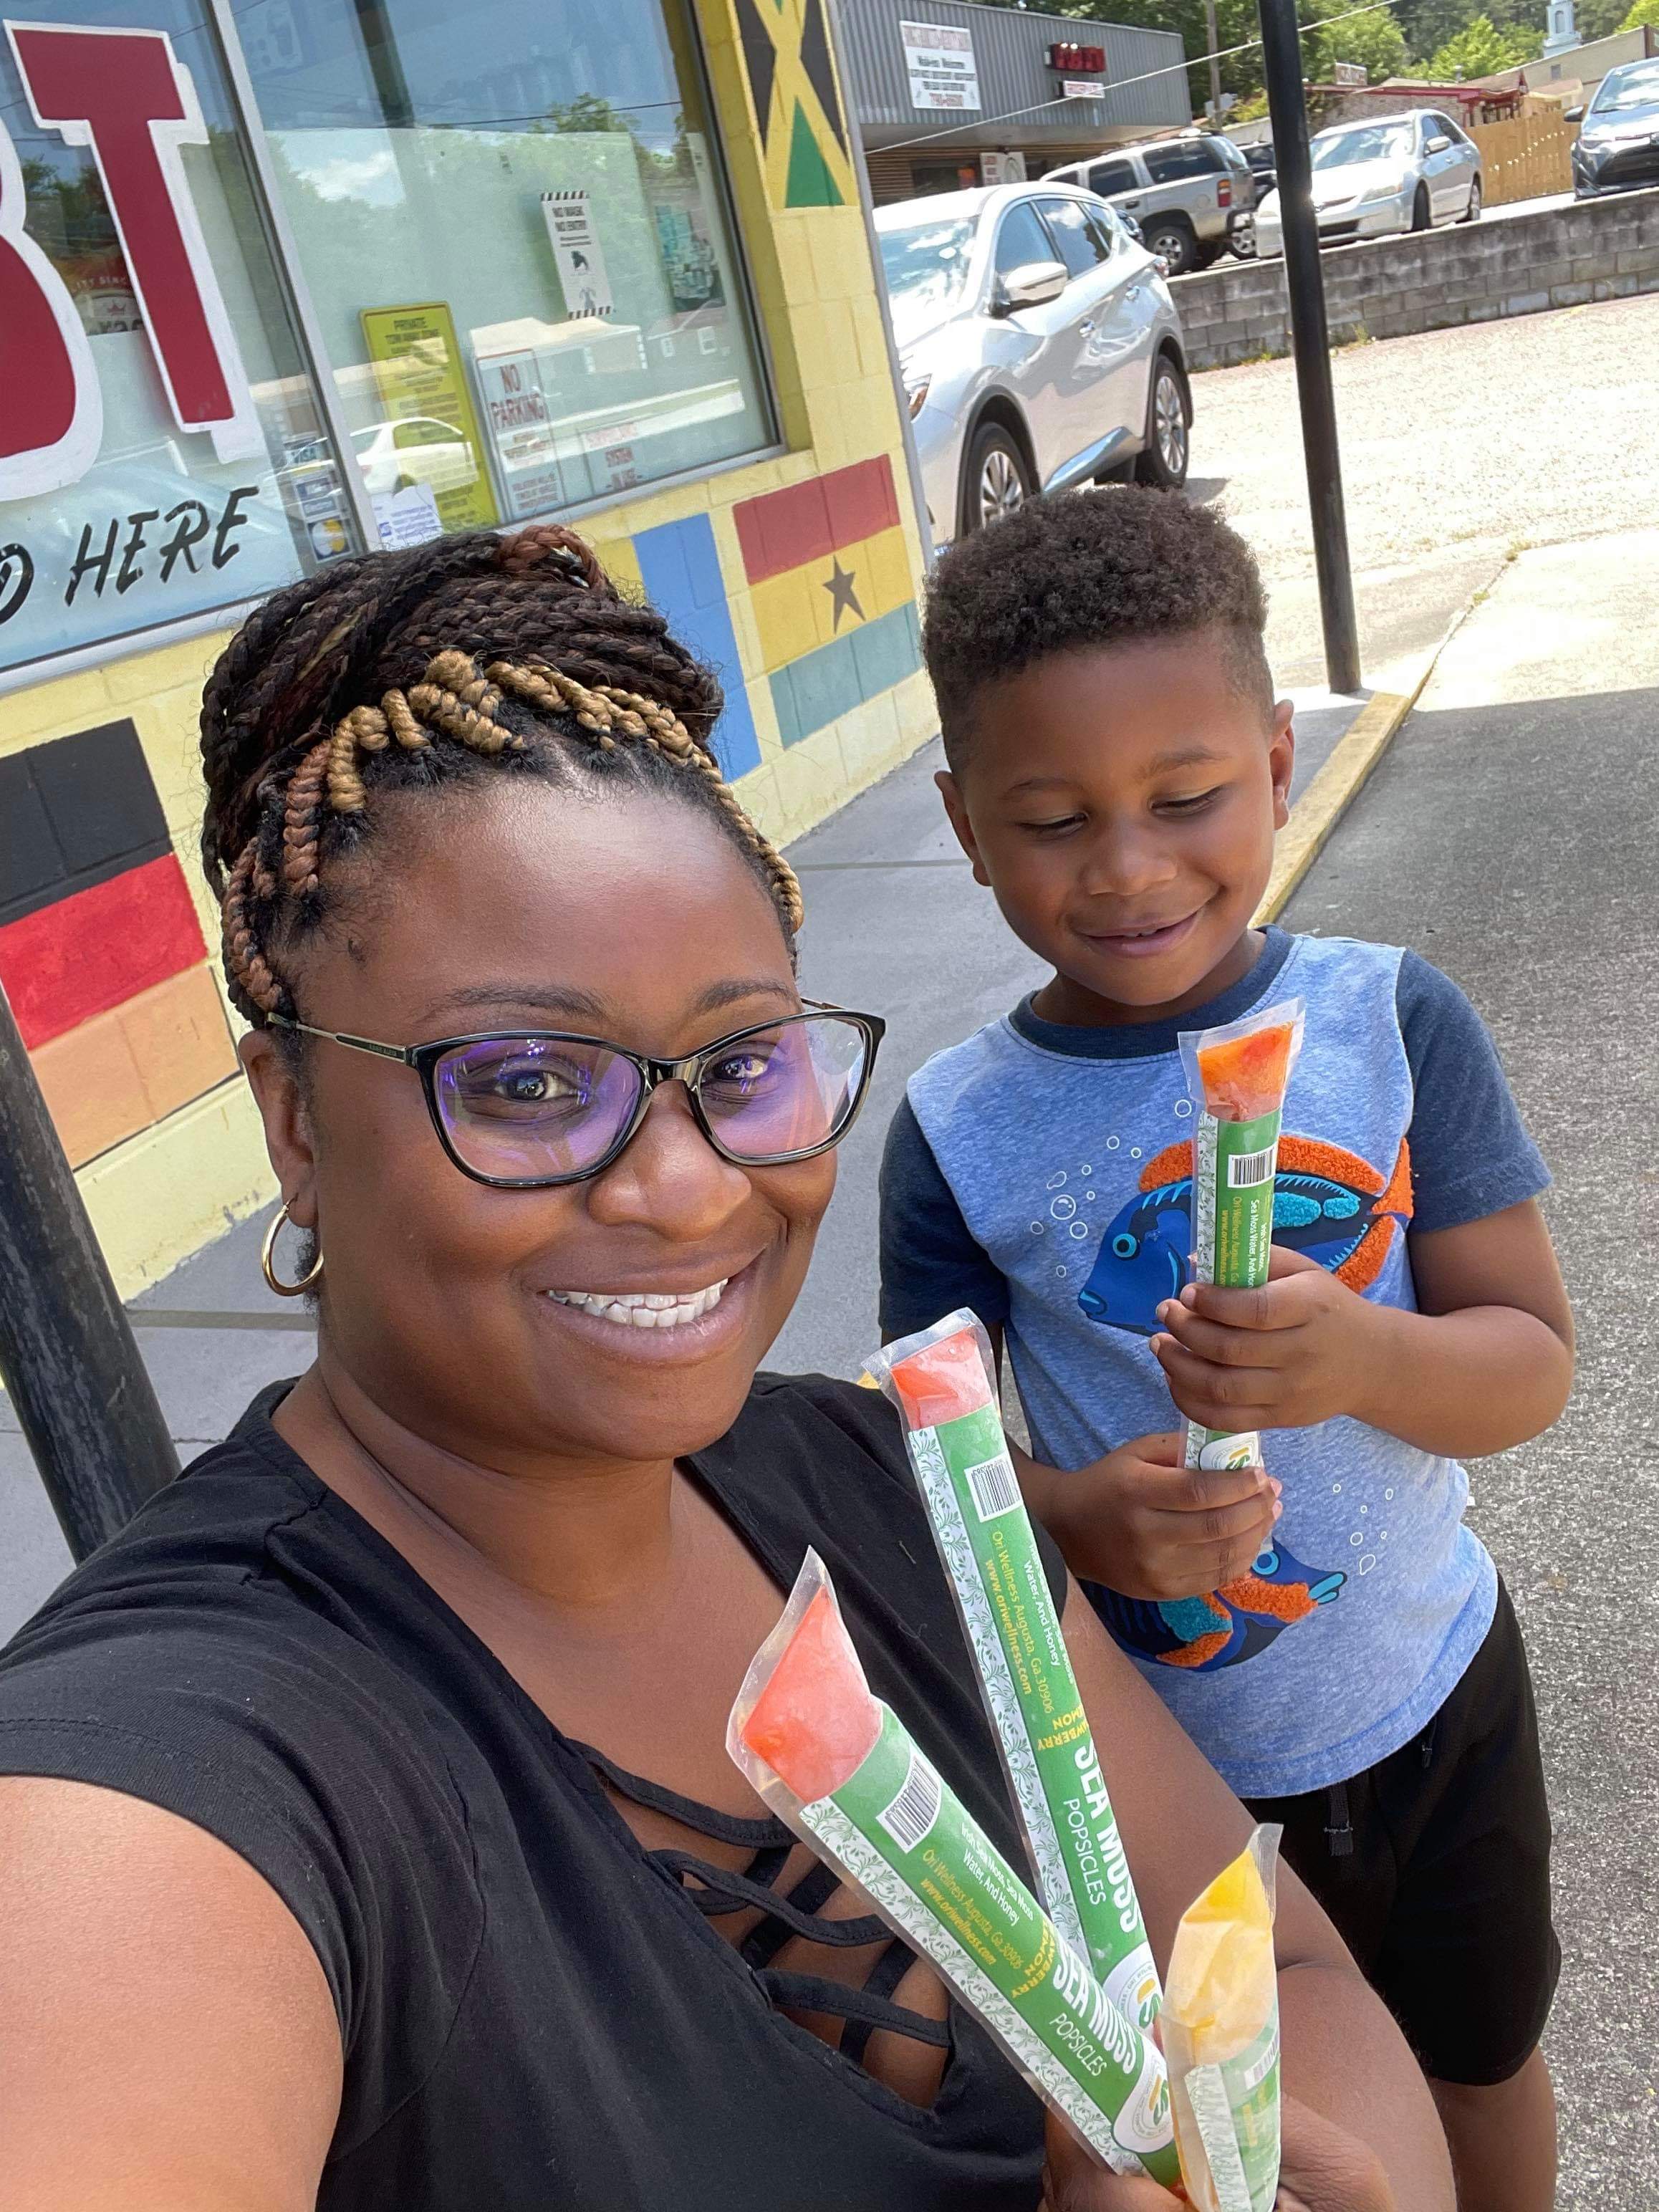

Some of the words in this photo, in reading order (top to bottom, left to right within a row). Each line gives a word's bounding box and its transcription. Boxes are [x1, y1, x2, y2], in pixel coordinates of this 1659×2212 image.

[490, 392, 546, 430] PARKING
[499, 364, 521, 394] NO
[64, 485, 260, 607] HERE
[985, 1559, 1032, 1696] www.oriwellness.com
[992, 1530, 1004, 1549] Ori
[999, 1549, 1020, 1603] Wellness
[1014, 1605, 1035, 1656] Augusta,
[1024, 1559, 1040, 1600] Water,
[1035, 1601, 1050, 1627] And
[1043, 1626, 1061, 1666] Honey
[923, 1849, 940, 1867] Ori
[934, 1860, 966, 1903] Wellness
[961, 1822, 976, 1850] Irish
[976, 1842, 988, 1865] Sea
[1006, 1878, 1017, 1902] Sea
[1017, 1893, 1034, 1921] Moss
[963, 1848, 984, 1885] Water,
[984, 1876, 999, 1900] And
[998, 1893, 1020, 1927] Honey
[1064, 1798, 1107, 1905] POPSICLES
[1074, 1741, 1111, 1819] SEA
[1097, 1819, 1141, 1933] MOSS
[920, 1877, 996, 1966] www.oriwellness.com
[1049, 2012, 1107, 2077] POPSICLES
[1053, 1939, 1090, 2018] SEA
[1088, 1980, 1136, 2074] MOSS
